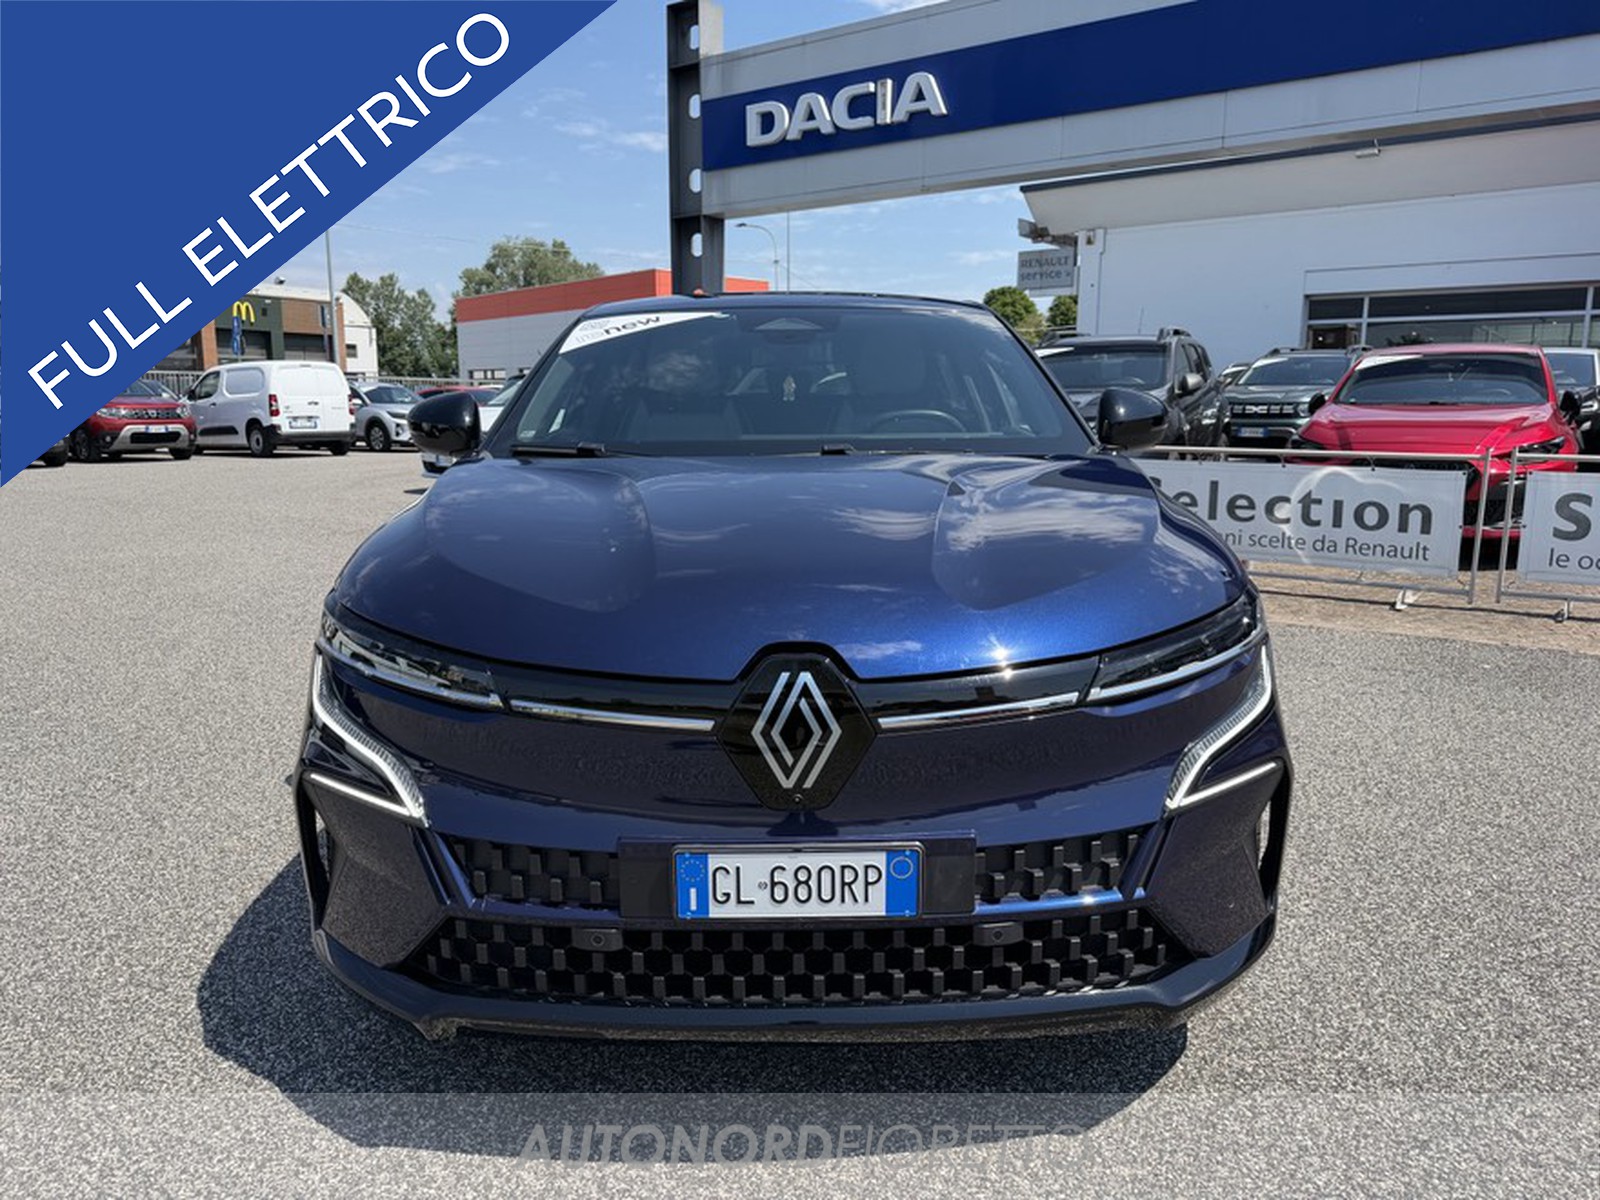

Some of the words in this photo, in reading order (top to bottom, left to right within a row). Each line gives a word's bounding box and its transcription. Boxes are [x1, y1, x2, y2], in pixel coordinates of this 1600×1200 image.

[746, 71, 948, 147] DACIA
[1020, 256, 1069, 268] RENAULT
[1149, 476, 1433, 535] election
[1248, 532, 1306, 551] scelte
[1312, 535, 1337, 554] da
[1345, 537, 1430, 561] Renault
[1548, 547, 1570, 568] le
[712, 866, 755, 905] GL
[769, 864, 882, 904] 680RP
